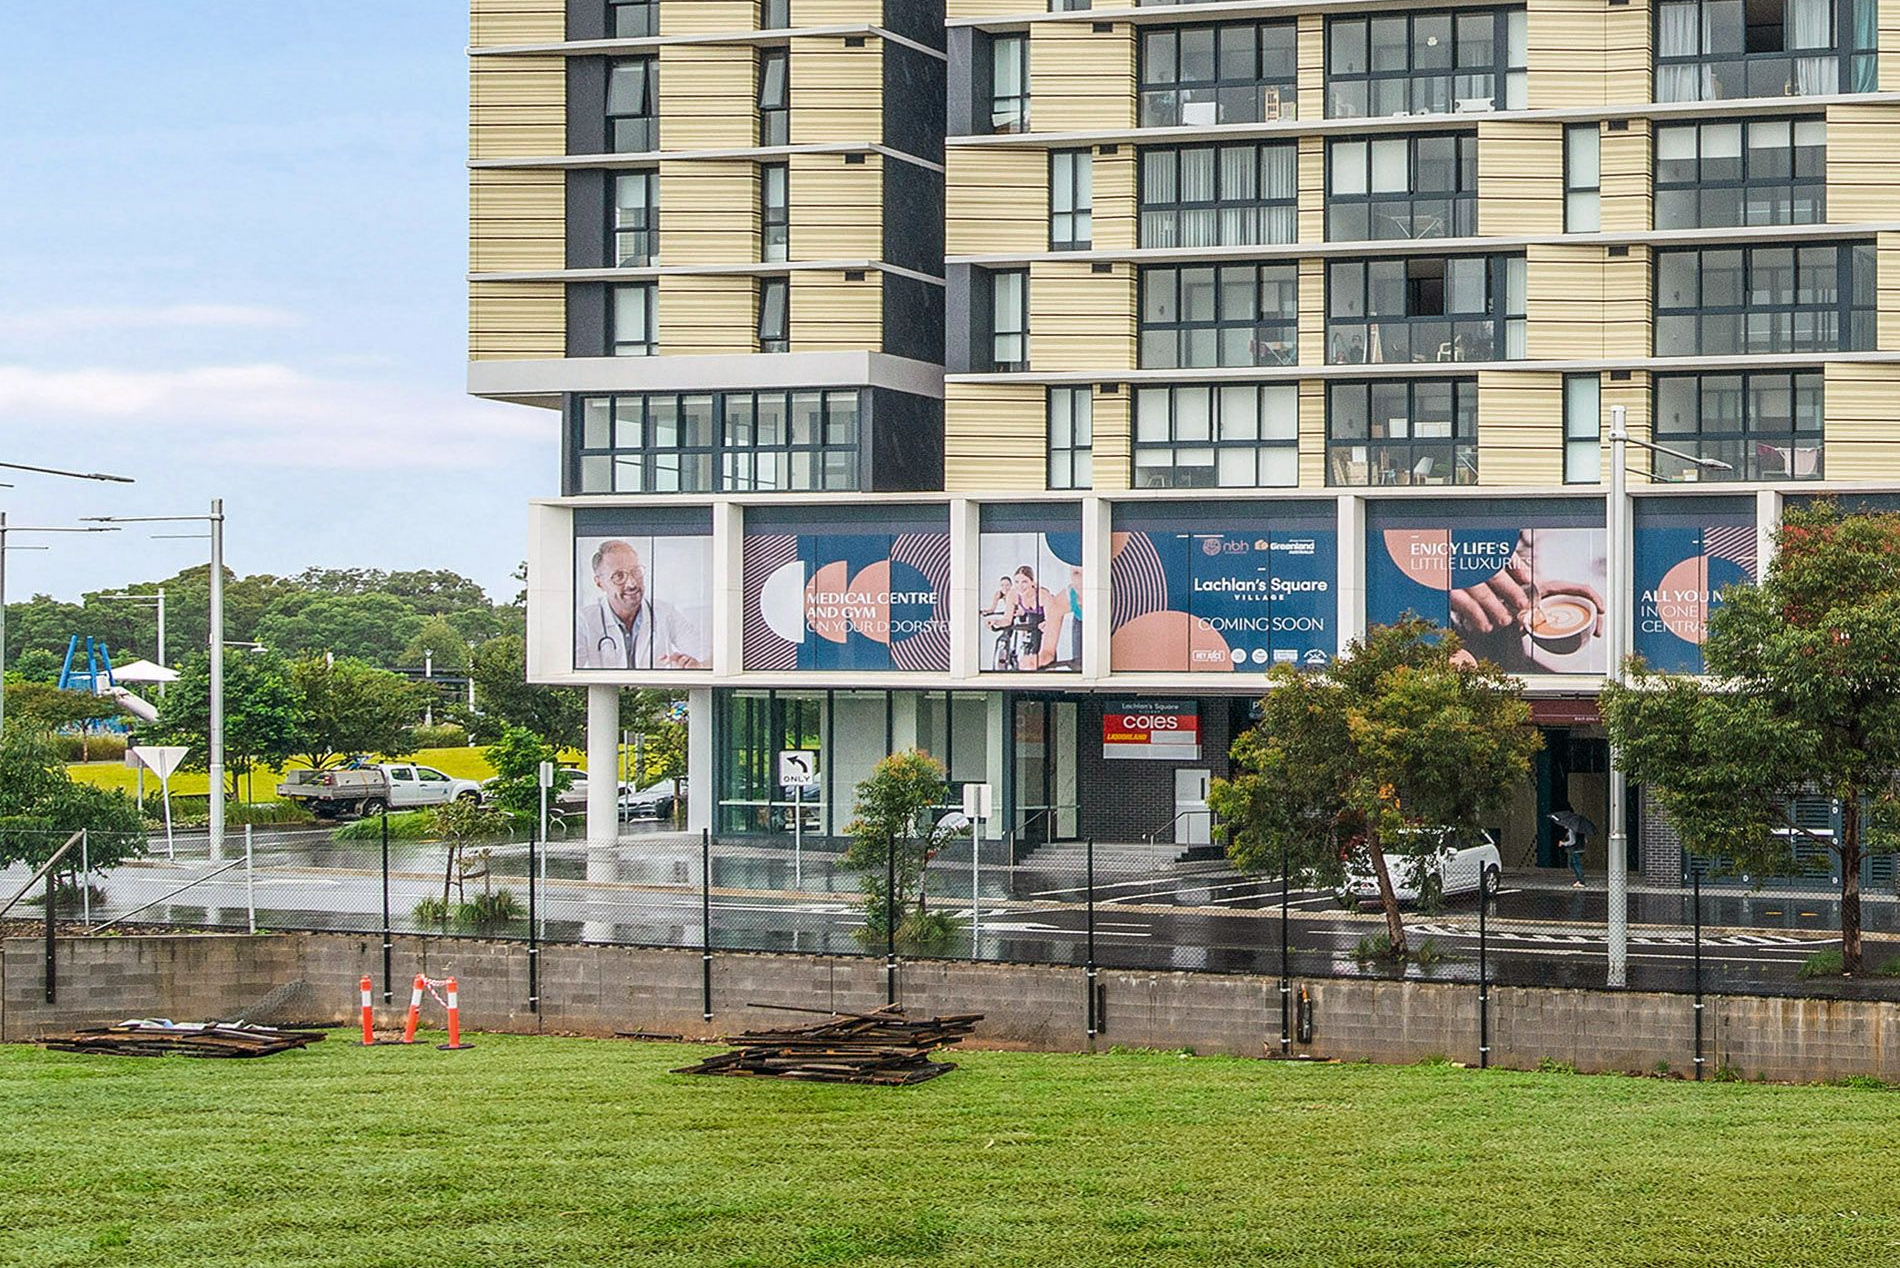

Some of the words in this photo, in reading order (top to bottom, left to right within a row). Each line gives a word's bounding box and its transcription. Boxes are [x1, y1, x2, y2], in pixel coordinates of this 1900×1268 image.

[1222, 540, 1249, 551] nbh
[1270, 542, 1315, 550] Greenland
[1410, 542, 1461, 556] ENJOY
[1463, 542, 1510, 555] LIFE'S
[1410, 557, 1456, 570] LITTLE
[1194, 577, 1267, 591] Lachlan's
[1270, 577, 1328, 594] Square
[806, 592, 875, 604] MEDICAL
[877, 592, 938, 604] CENTRE
[1641, 590, 1672, 602] ALL
[1674, 590, 1709, 602] YOU
[806, 607, 839, 618] AND
[841, 607, 876, 618] GYM
[1641, 605, 1658, 617] IN
[1662, 605, 1699, 617] ONE
[806, 620, 829, 632] ON
[832, 620, 876, 632] YOUR
[877, 620, 951, 632] DOORSTE
[1198, 617, 1269, 631] COMING
[1272, 617, 1324, 631] SOON
[1154, 703, 1180, 711] Square
[1123, 715, 1179, 729] coles
[1106, 733, 1148, 741] LIQUORLAND
